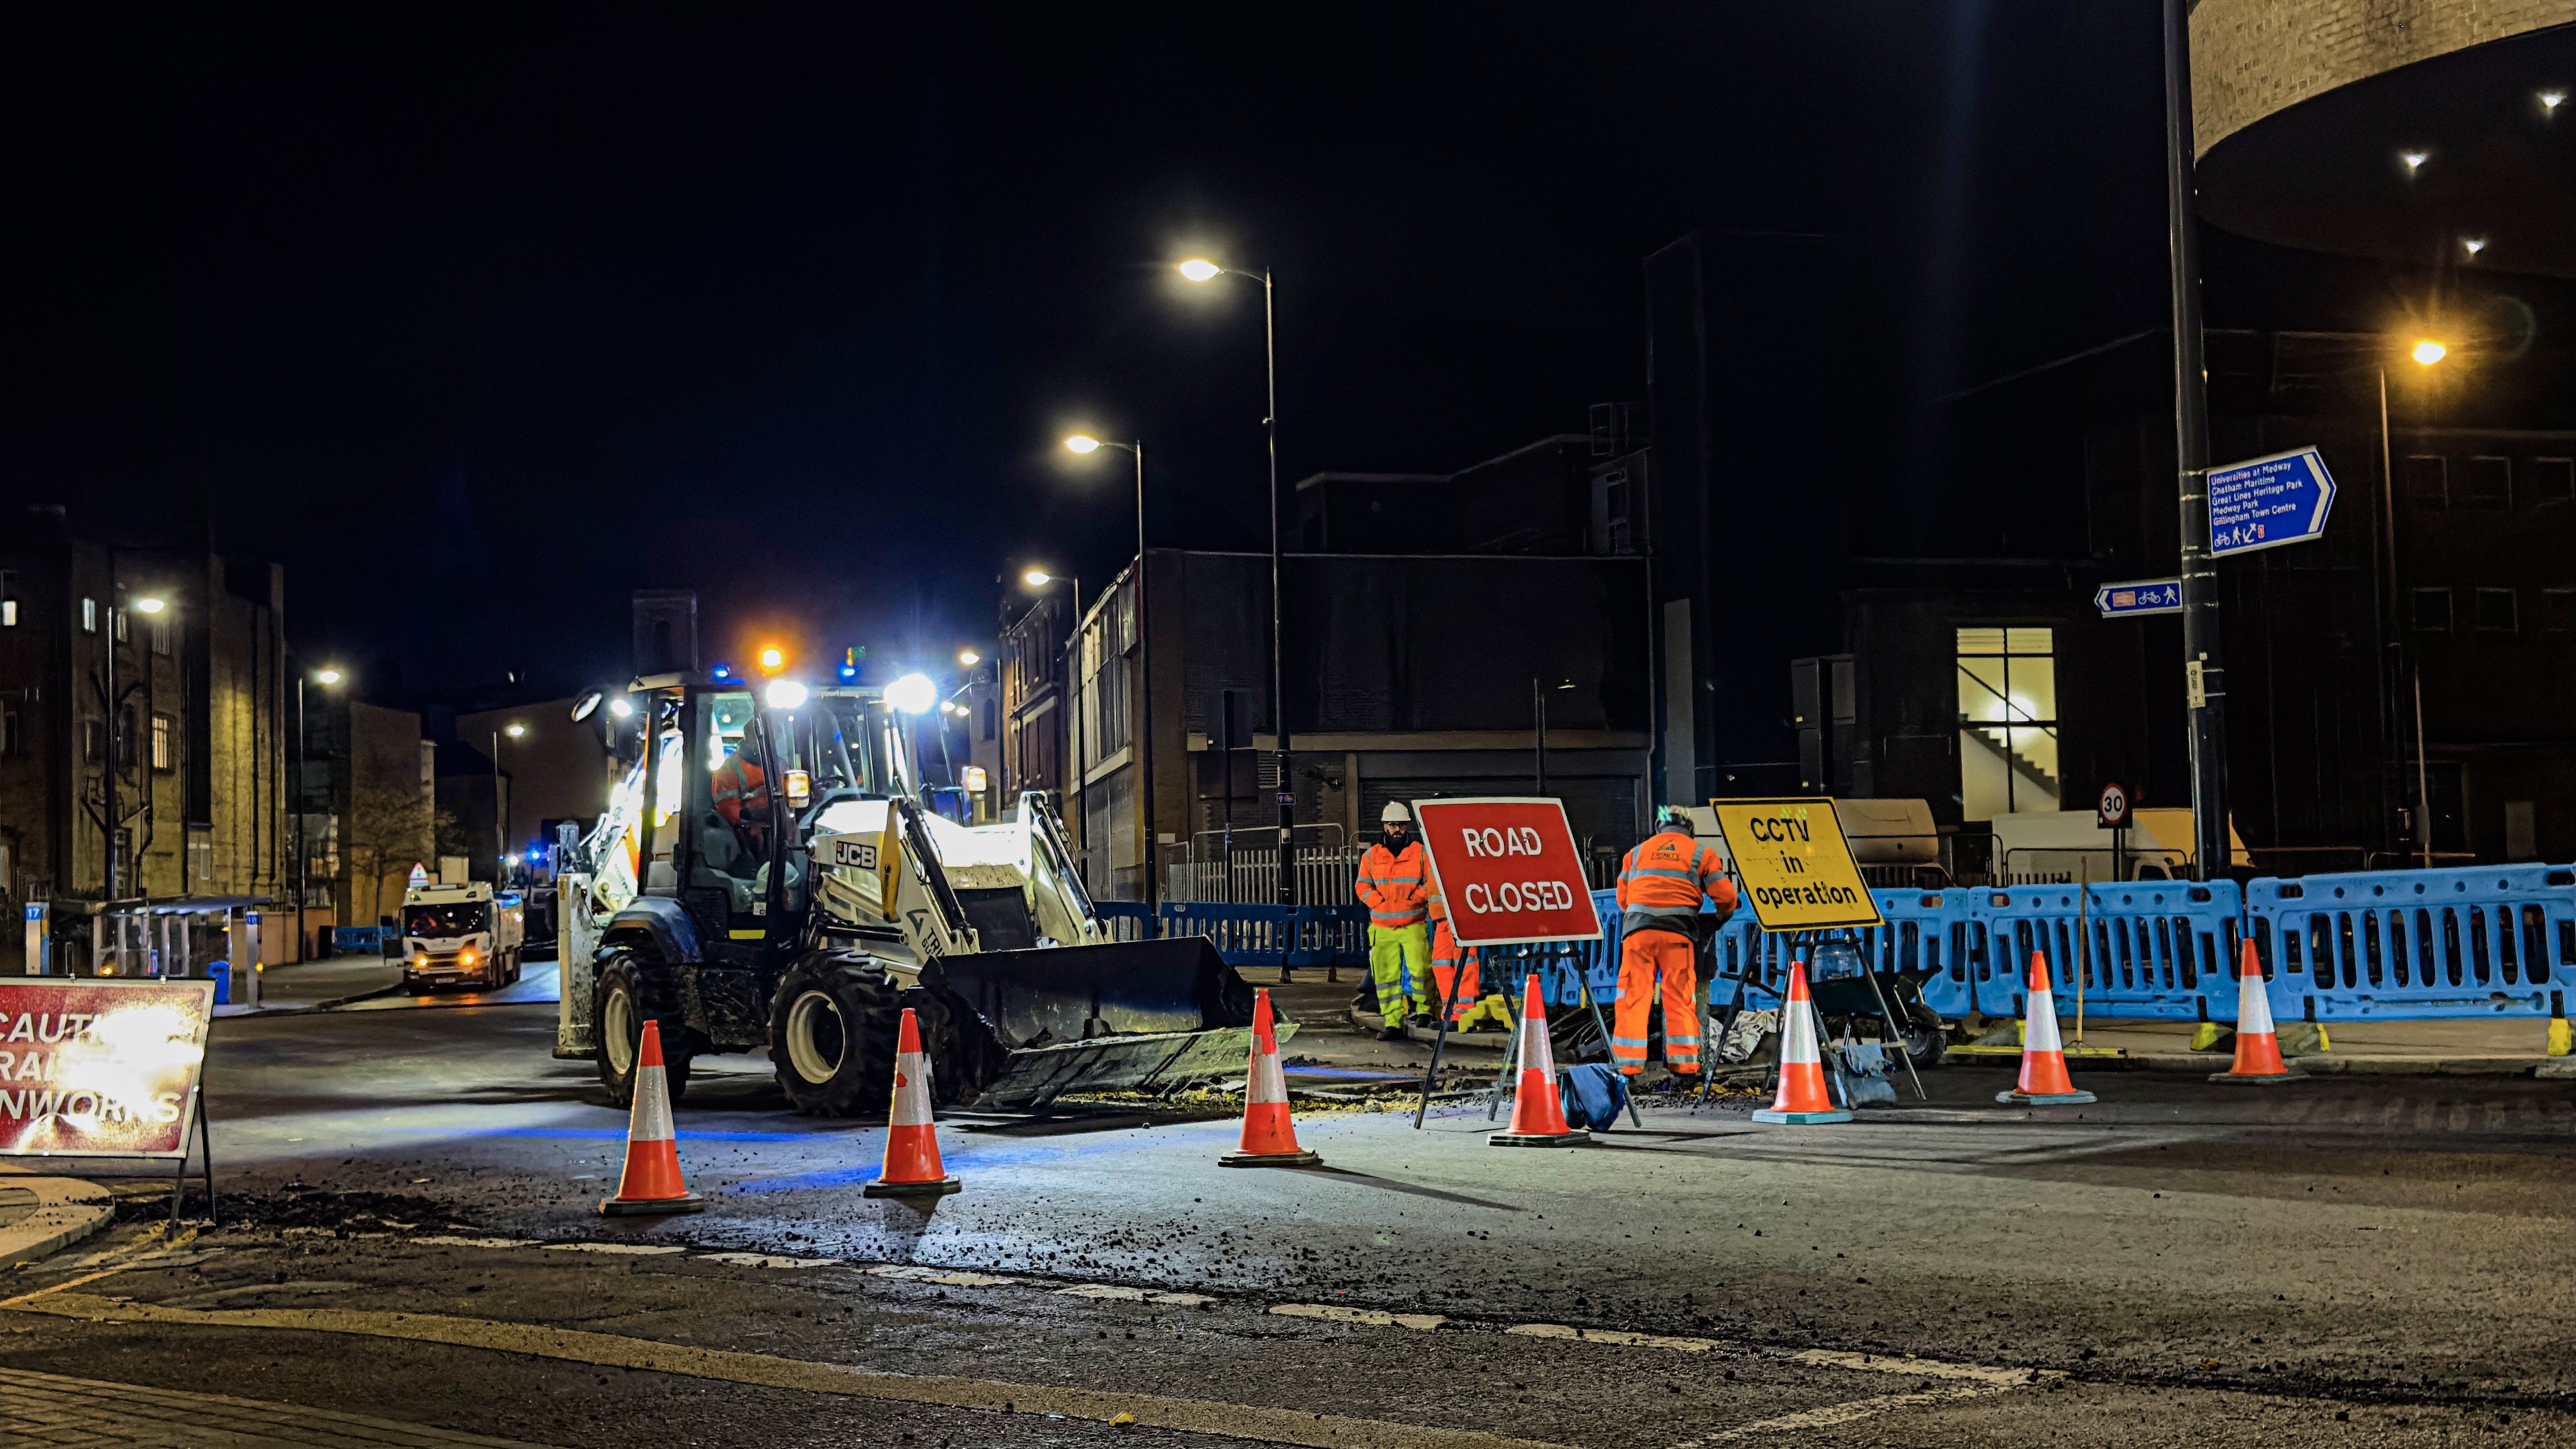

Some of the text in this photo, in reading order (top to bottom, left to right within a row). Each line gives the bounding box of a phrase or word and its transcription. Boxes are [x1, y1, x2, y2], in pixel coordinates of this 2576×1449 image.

[2211, 462, 2291, 486] Universities at Medway
[2212, 476, 2275, 496] Chatham Maritime
[2212, 479, 2303, 506] Great Lines Heritage Park
[2213, 499, 2259, 516] Medway Park
[2213, 503, 2296, 526] Gillingham Town Centre
[2104, 796, 2122, 812] 30
[1750, 817, 1810, 842] CCTV
[1462, 827, 1542, 857] ROAD
[837, 843, 875, 868] JCB
[1780, 850, 1805, 873] in
[1465, 881, 1573, 914] CLOSED
[1756, 881, 1858, 909] operation
[28, 908, 40, 919] 17
